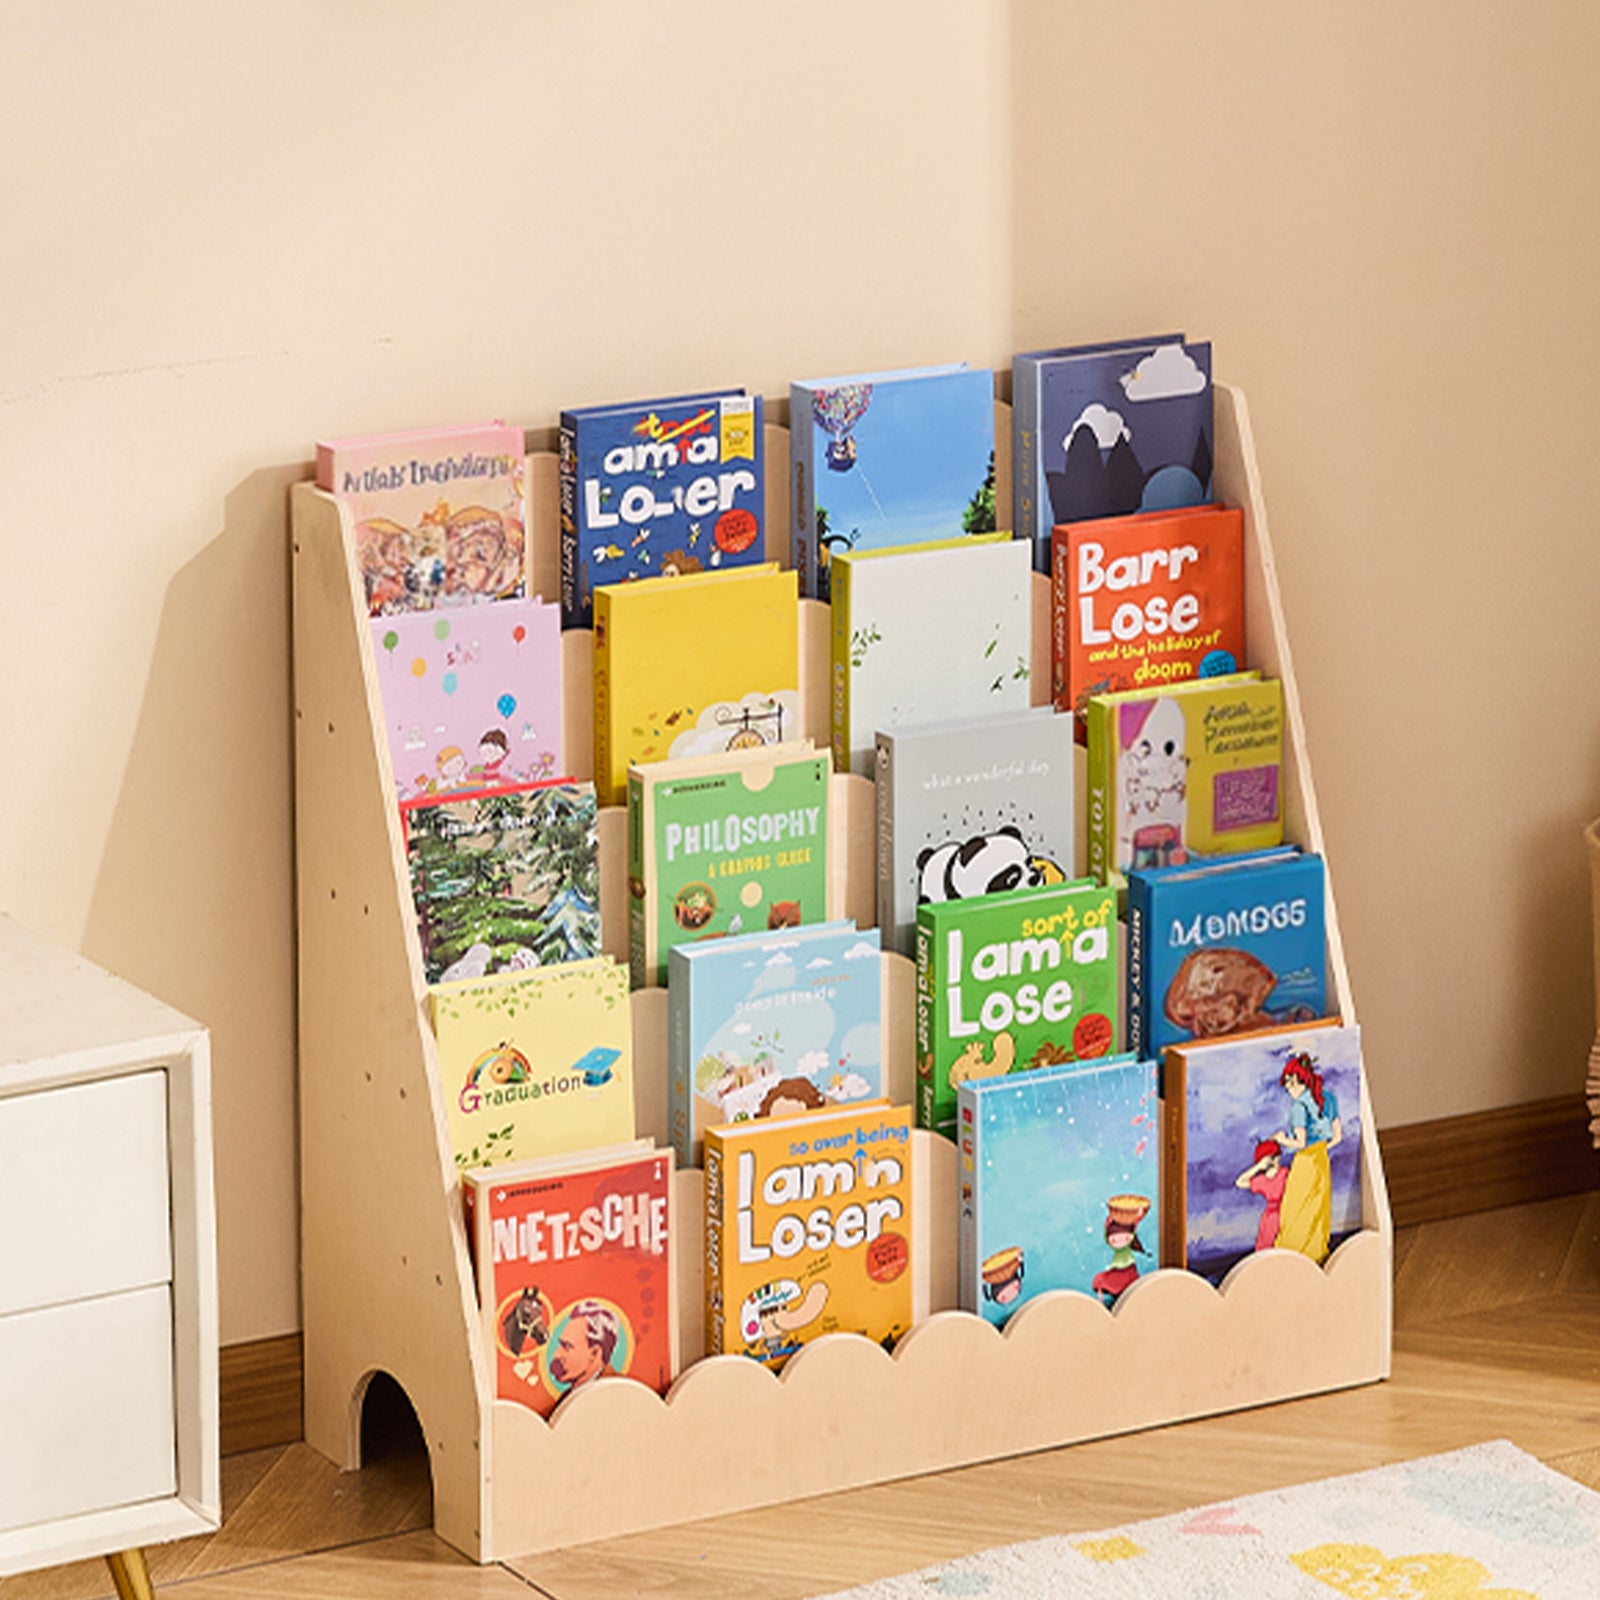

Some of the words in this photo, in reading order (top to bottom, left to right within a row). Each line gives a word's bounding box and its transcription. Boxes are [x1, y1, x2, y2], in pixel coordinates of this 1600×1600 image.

[603, 442, 680, 475] am
[687, 436, 719, 465] a
[1078, 542, 1199, 594] Barr
[1078, 594, 1199, 646] Lose
[1089, 643, 1119, 663] and
[1121, 643, 1146, 660] the
[1134, 657, 1193, 684] doom
[665, 806, 821, 863] PHILOSOPHY
[1022, 904, 1080, 938] sort
[1083, 898, 1113, 930] of
[947, 929, 963, 984] I
[971, 937, 1062, 982] am
[1072, 926, 1109, 964] a
[947, 980, 1073, 1038] Lose
[458, 1074, 583, 1115] Graduation
[789, 1141, 809, 1157] so
[812, 1132, 854, 1153] over
[855, 1122, 909, 1145] being
[737, 1151, 755, 1208] I
[763, 1160, 856, 1207] am
[492, 1193, 668, 1264] NIETZSCHE
[737, 1196, 903, 1264] Loser
